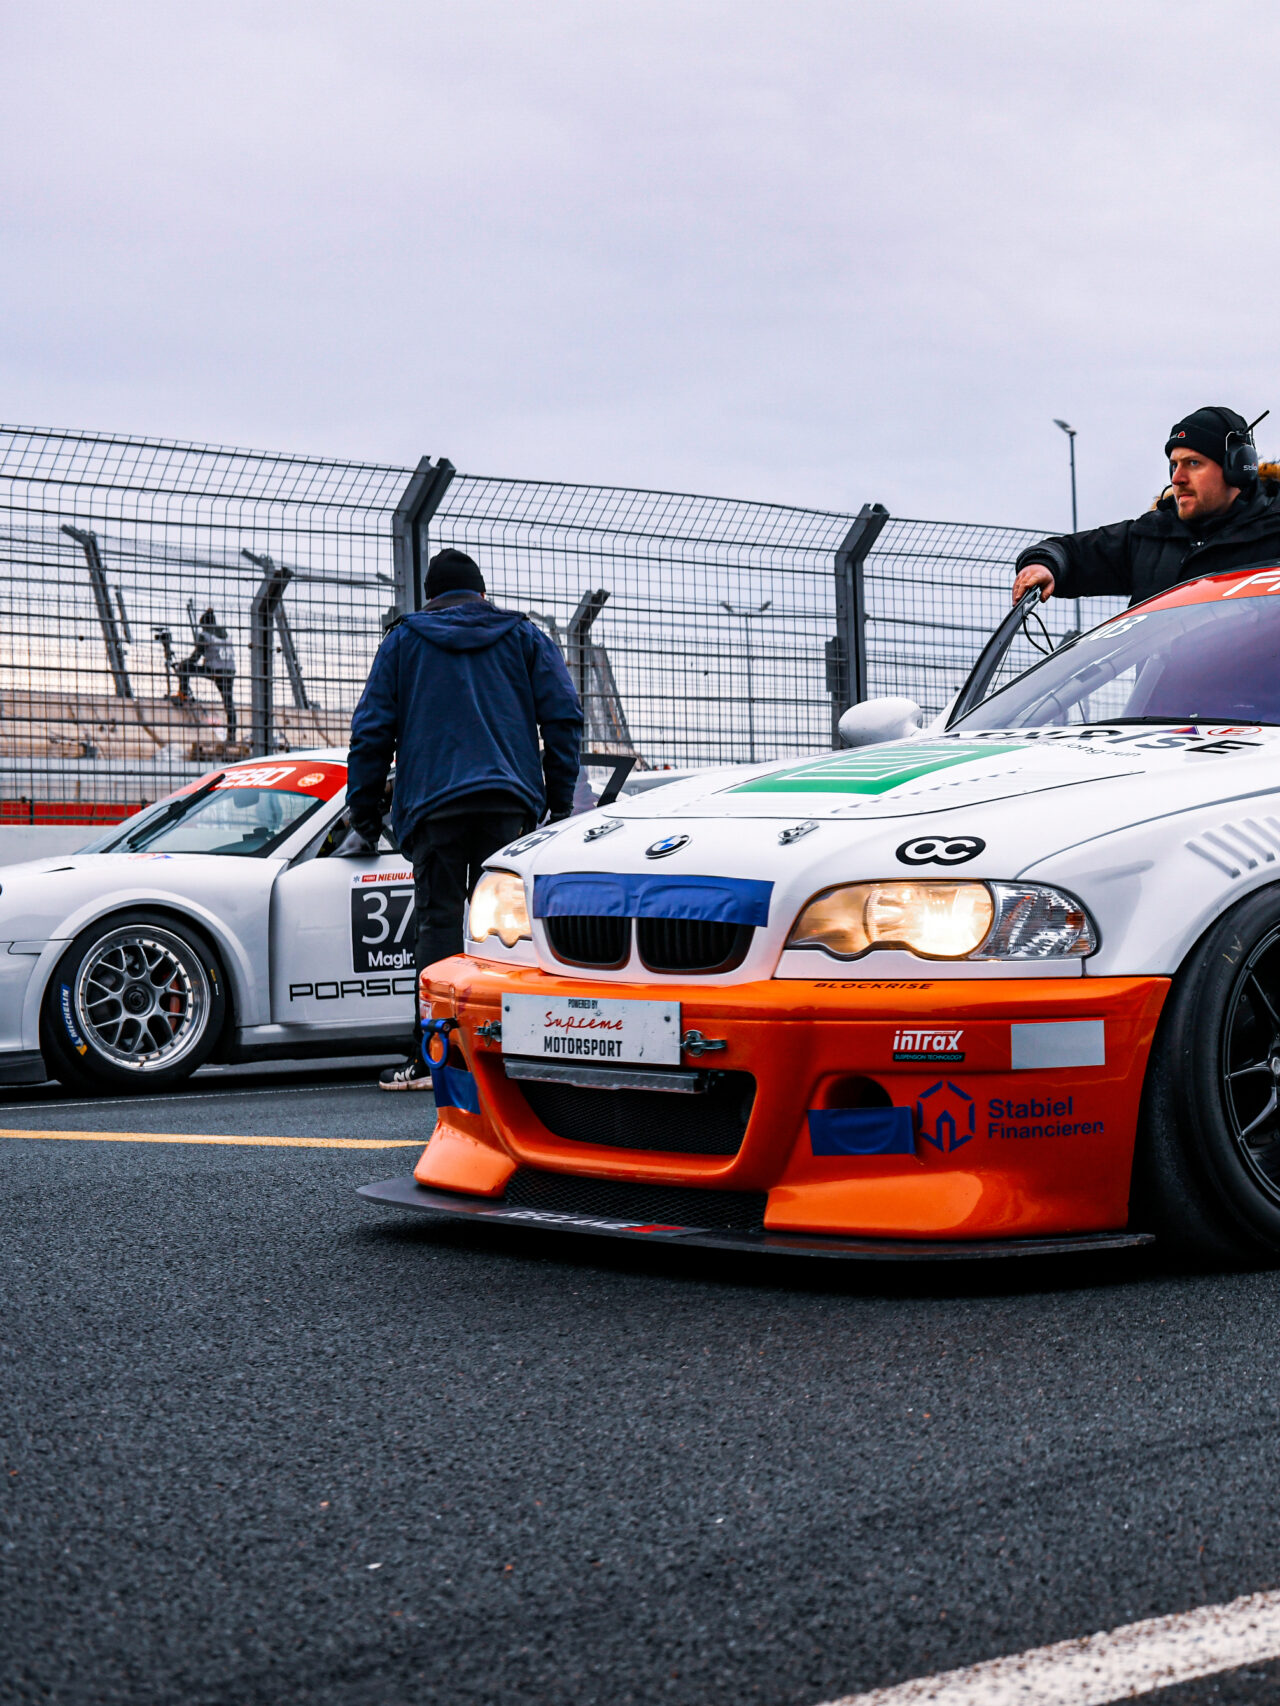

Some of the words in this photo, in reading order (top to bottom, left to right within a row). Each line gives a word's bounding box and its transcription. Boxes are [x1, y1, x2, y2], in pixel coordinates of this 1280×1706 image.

[1084, 614, 1149, 642] 03
[377, 872, 415, 882] NIEUWJ
[361, 889, 415, 945] 37
[368, 949, 415, 969] Maglr.
[289, 977, 415, 1001] PORSC
[62, 988, 78, 1039] MICHELIN
[568, 998, 591, 1010] POWERED
[592, 1000, 598, 1010] BY
[544, 1011, 624, 1034] Supreme
[544, 1035, 623, 1058] MOTORSPORT
[893, 1030, 964, 1051] inTrax
[988, 1097, 1073, 1119] Stabiel
[988, 1121, 1104, 1139] Financieren
